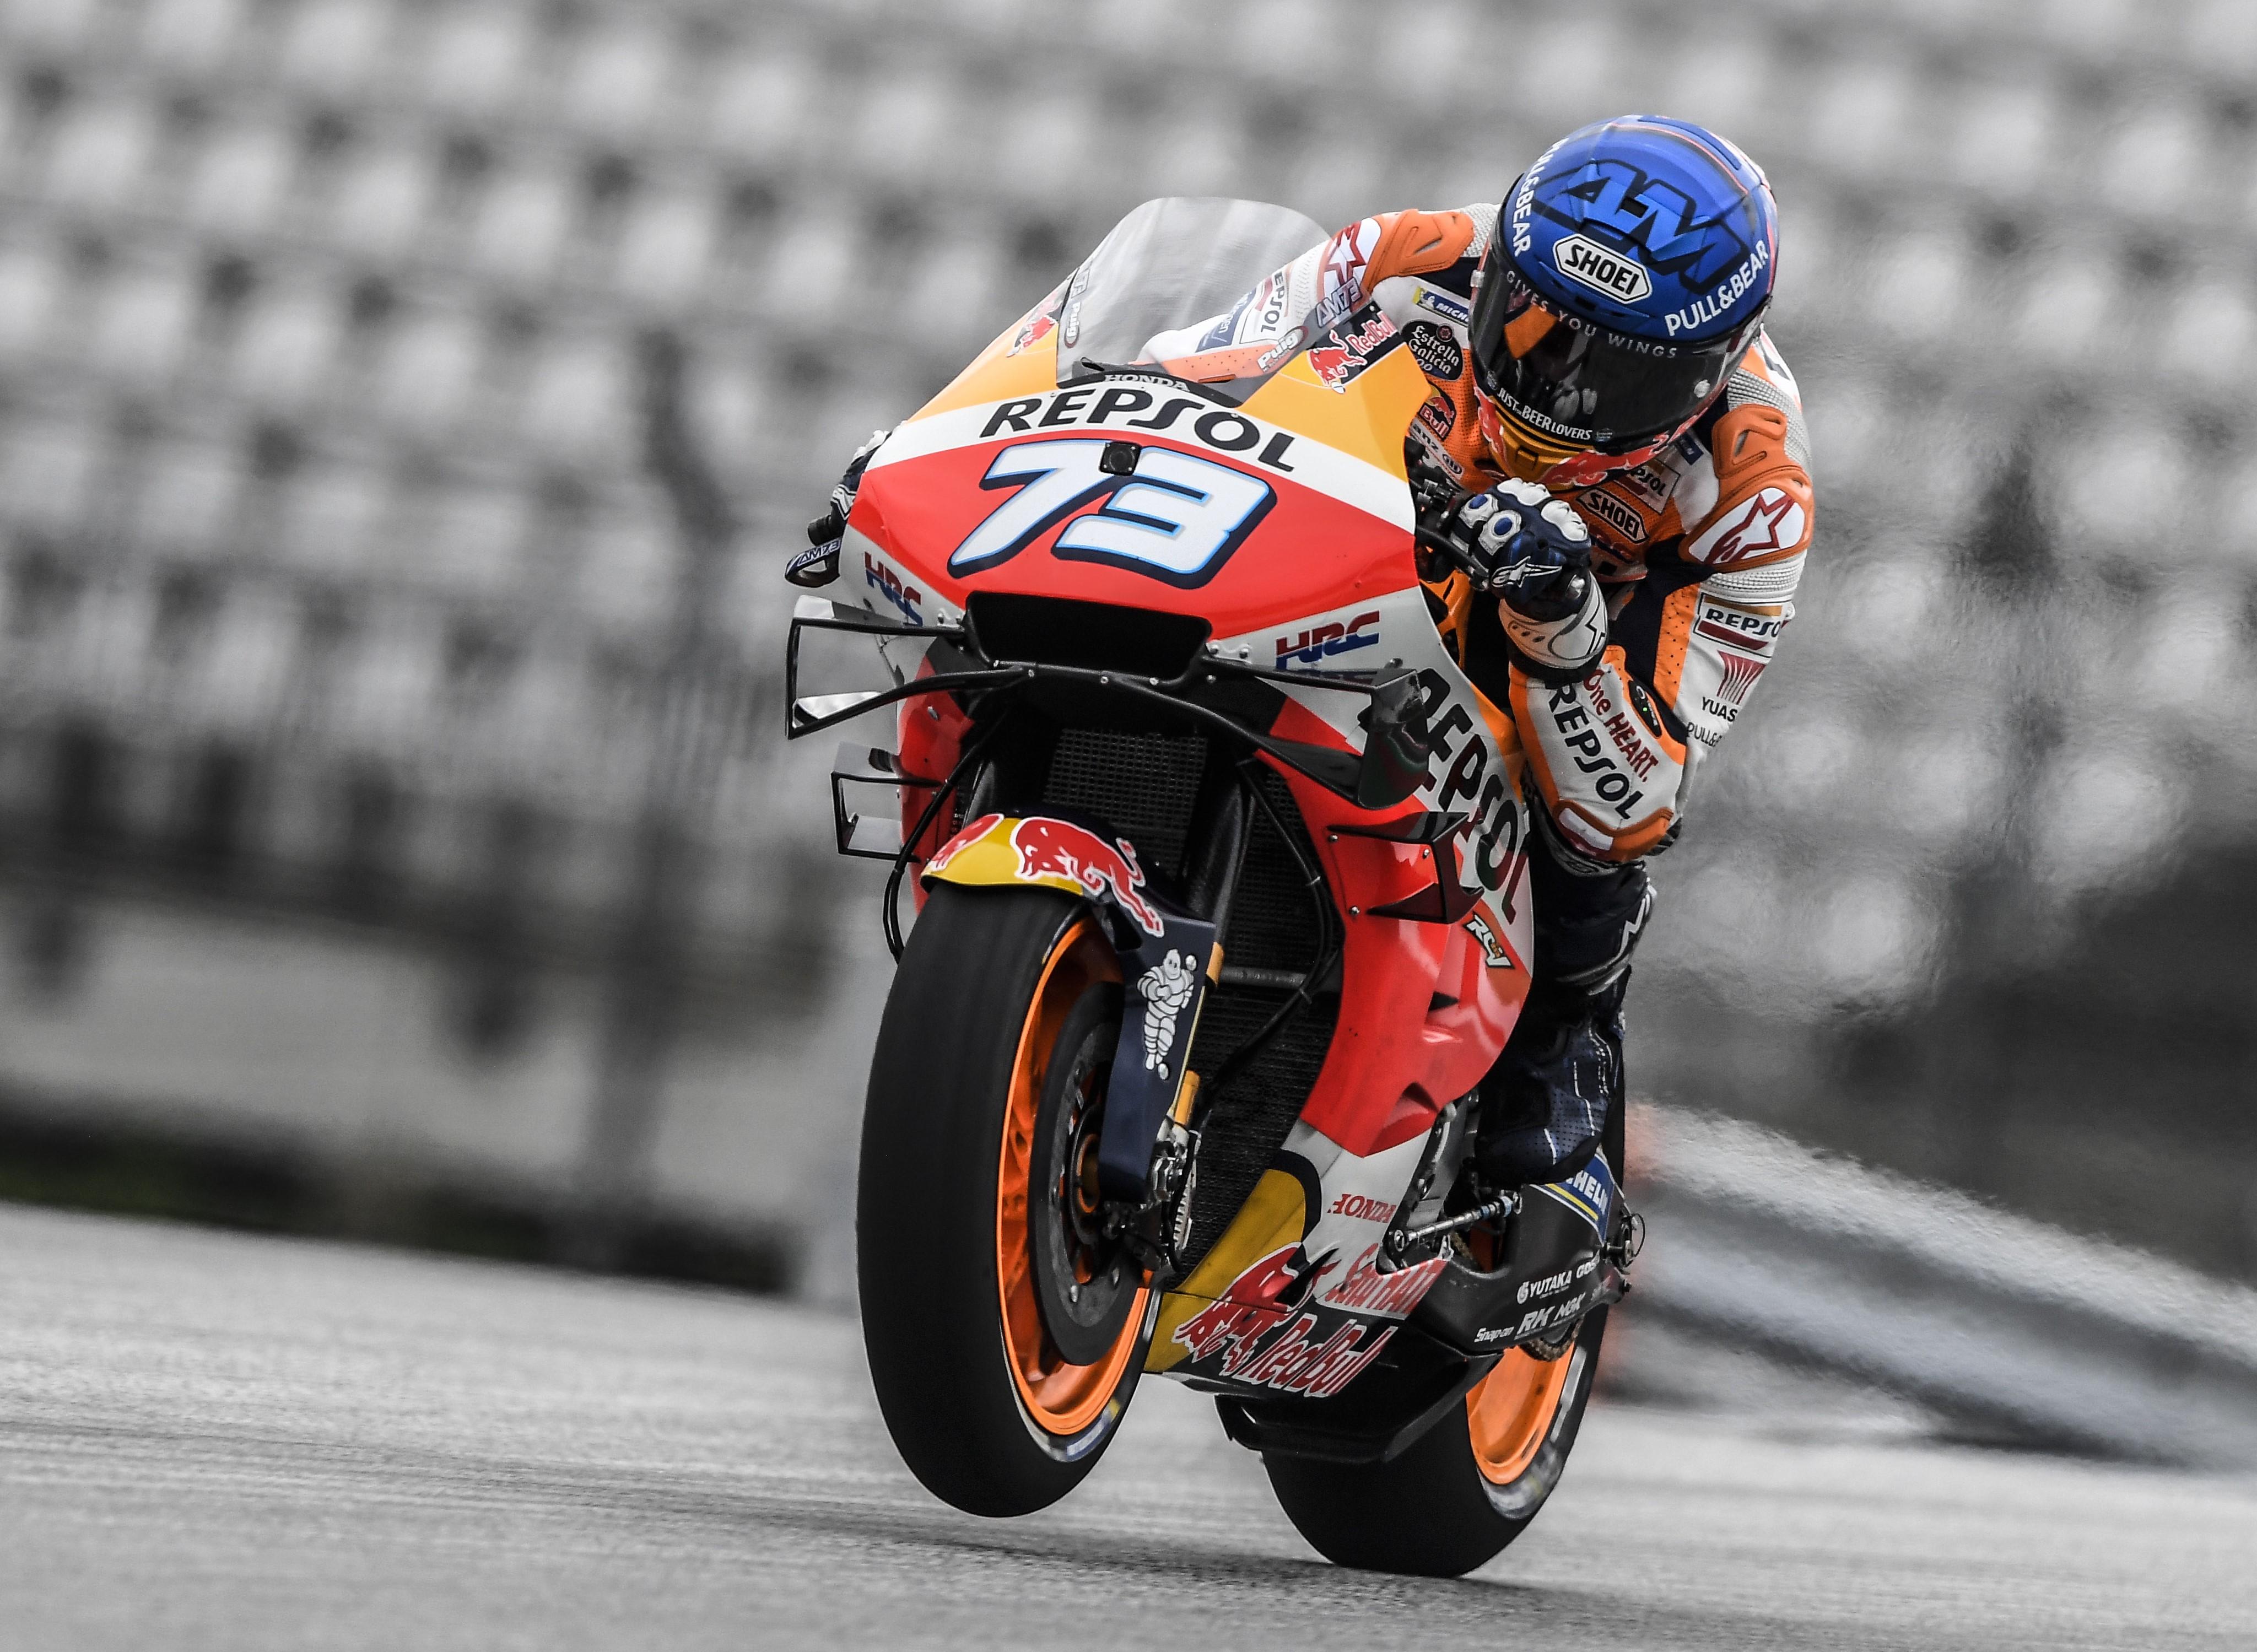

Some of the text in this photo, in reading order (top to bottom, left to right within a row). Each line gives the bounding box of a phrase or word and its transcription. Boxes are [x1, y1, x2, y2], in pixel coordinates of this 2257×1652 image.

[1565, 244, 1639, 295] SHOEI
[1664, 240, 1769, 337] PULL&BEAR
[1261, 272, 1285, 333] EPSOL
[1435, 303, 1470, 322] MICH
[1506, 270, 1677, 359] GIVES YOU WINGS
[1257, 332, 1298, 369] Puig
[1408, 338, 1451, 374] Galicia
[1411, 325, 1460, 366] Estrella
[1104, 374, 1191, 392] HONDA
[979, 388, 1296, 473] REPSOL
[1497, 387, 1520, 411] JUST
[1521, 405, 1552, 431] BEER
[1551, 422, 1593, 440] LOVERS
[1630, 468, 1667, 496] PSOL
[947, 438, 1277, 590] 73
[1587, 492, 1640, 539] SHOEI
[864, 551, 924, 627] HRC
[1276, 611, 1380, 668] HRC
[1705, 608, 1781, 638] REPSO
[1583, 668, 1659, 782] One HEART.
[1702, 697, 1738, 722] YUAS
[1548, 683, 1644, 820] REPSOL
[1687, 721, 1723, 748] PULL&
[1565, 1170, 1608, 1214] HELIN
[1530, 1270, 1573, 1298] YUTAKA
[1576, 1261, 1597, 1278] GOS
[1516, 1305, 1556, 1335] RK
